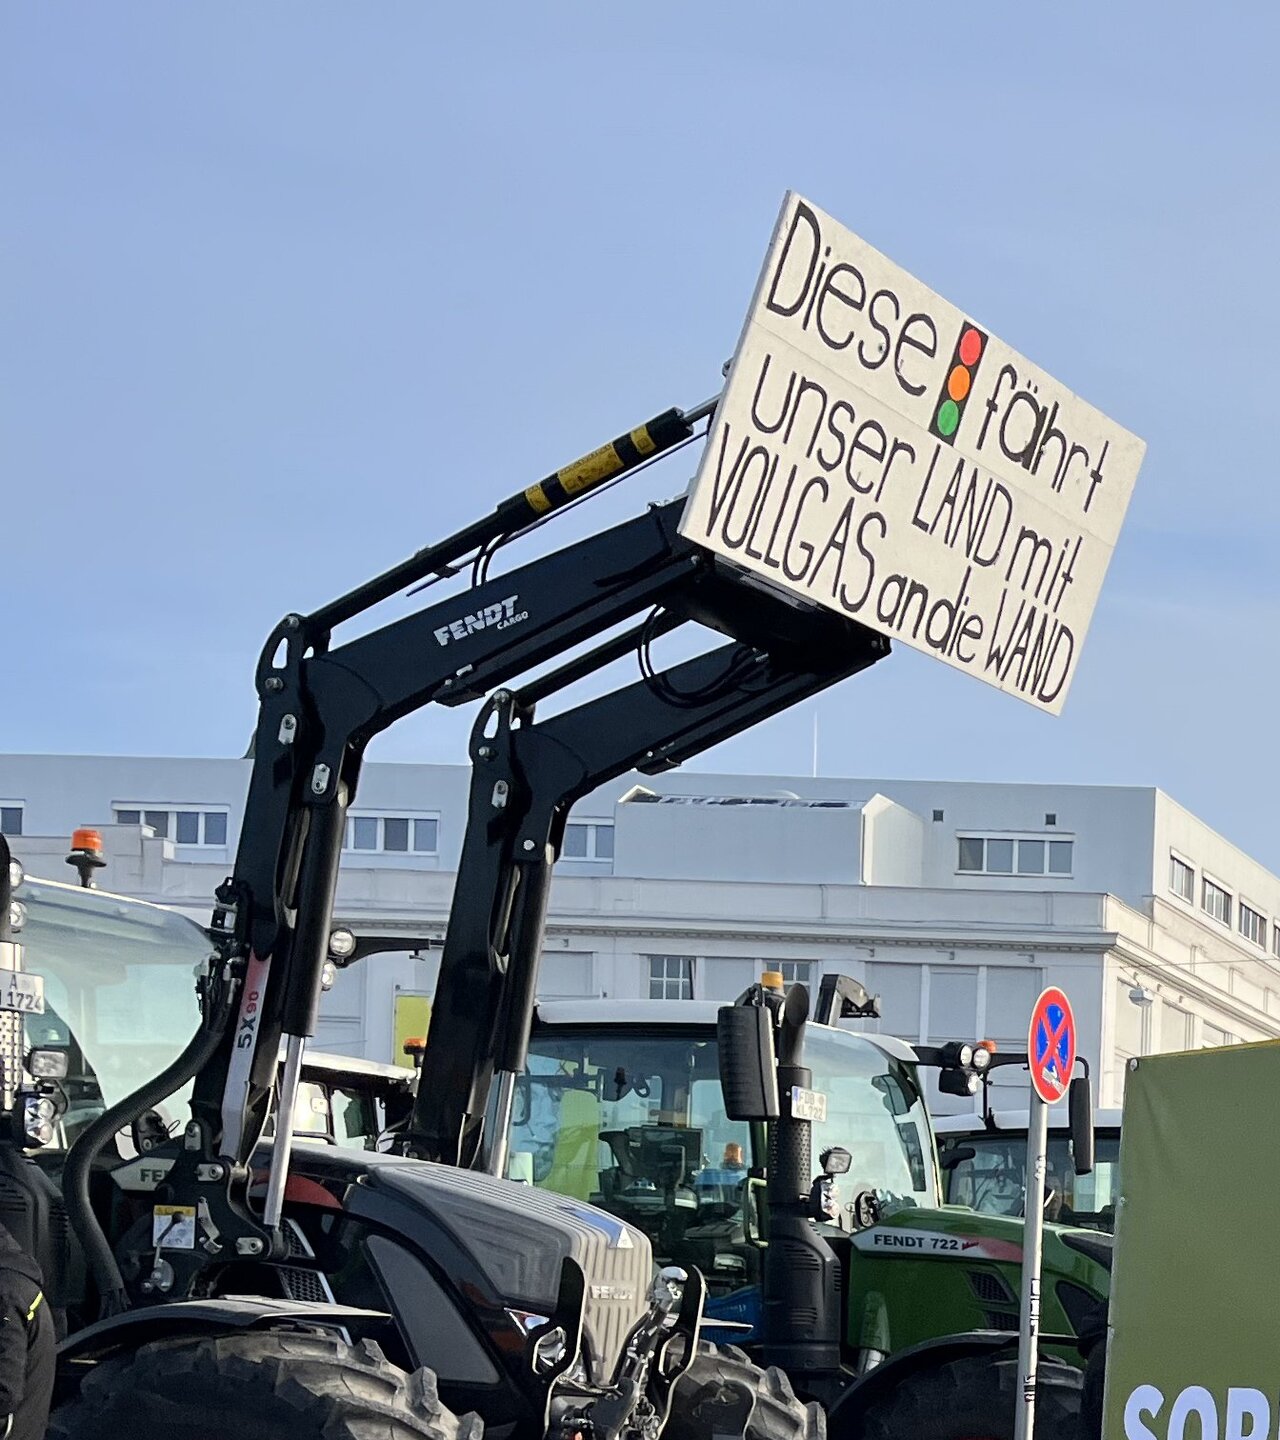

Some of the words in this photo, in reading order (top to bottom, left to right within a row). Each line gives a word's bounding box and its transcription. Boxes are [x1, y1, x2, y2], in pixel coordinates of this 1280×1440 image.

[767, 199, 937, 397] Diese
[976, 364, 1110, 513] fährt
[750, 354, 915, 502] unser
[912, 444, 1013, 567] LAND
[1005, 525, 1083, 613] mit
[705, 423, 887, 613] VOLLGAS
[984, 587, 1074, 703] WAND
[433, 594, 519, 647] FENDT
[496, 610, 529, 630] CARGO
[140, 1167, 170, 1183] FE
[873, 1233, 925, 1248] FENDT
[930, 1237, 959, 1250] 722
